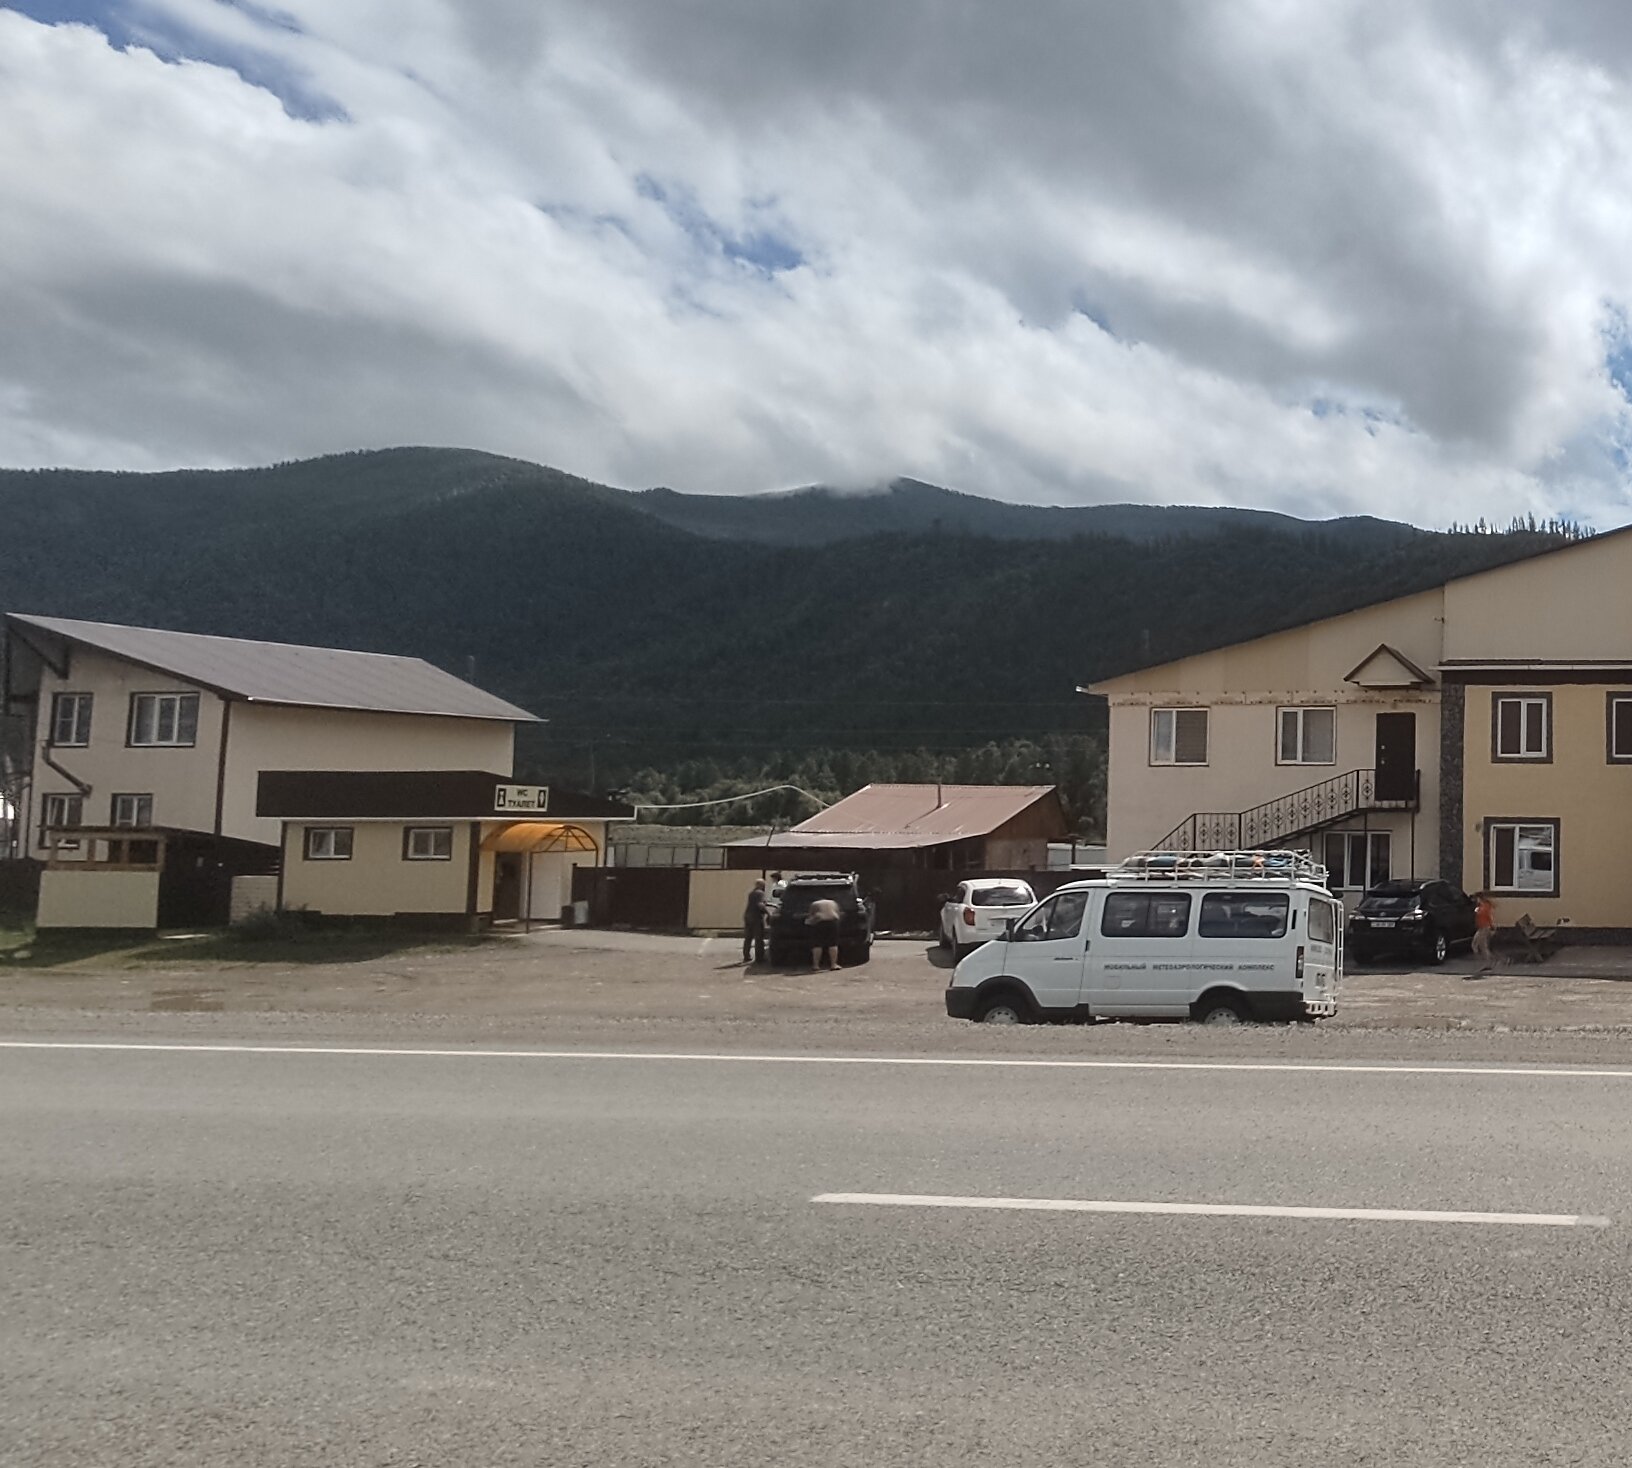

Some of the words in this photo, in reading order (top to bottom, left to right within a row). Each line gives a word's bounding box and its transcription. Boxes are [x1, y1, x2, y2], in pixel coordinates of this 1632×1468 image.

[516, 789, 528, 797] WC
[508, 800, 535, 808] ТУАЛЕТ
[1103, 962, 1147, 970] МОБИЛЬНЫЙ
[1238, 963, 1275, 971] КОМПЛЕКС
